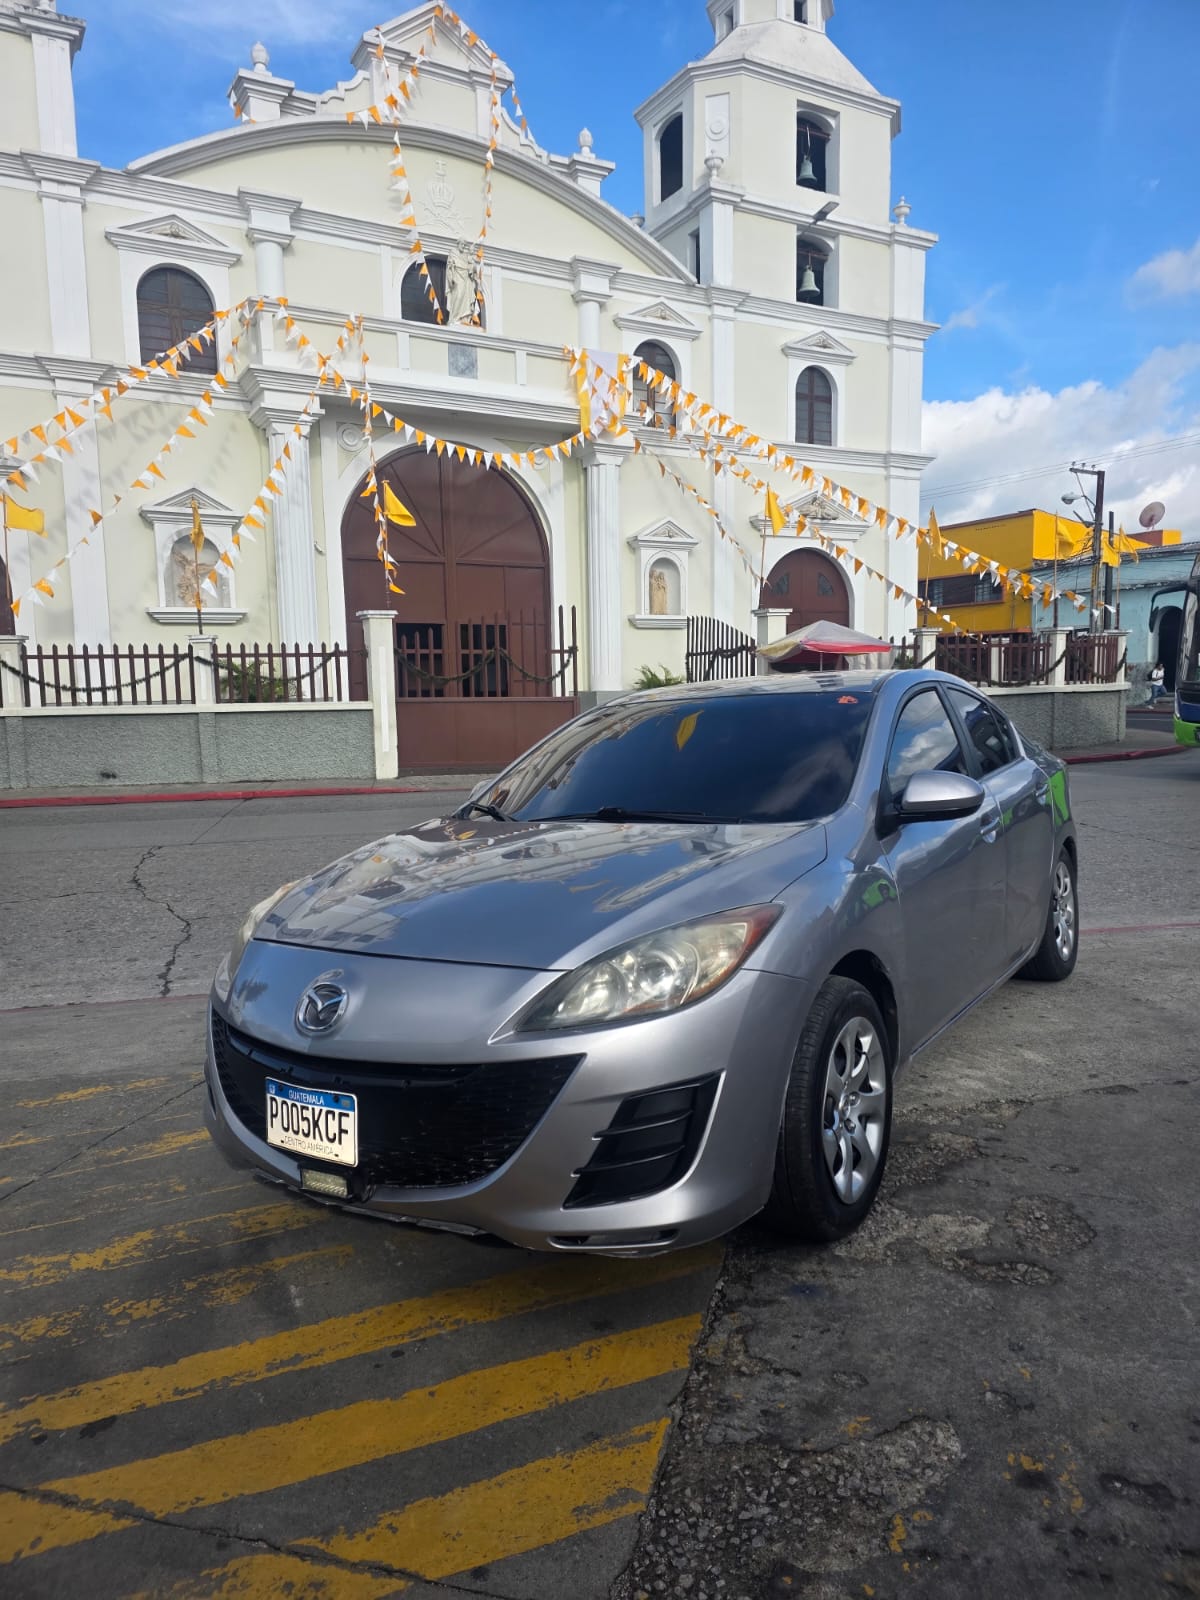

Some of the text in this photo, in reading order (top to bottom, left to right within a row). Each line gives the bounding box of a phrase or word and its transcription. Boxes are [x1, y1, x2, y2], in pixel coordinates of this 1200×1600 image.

[288, 1090, 325, 1105] GUATEMALA
[269, 1096, 350, 1146] P005KCF
[284, 1135, 307, 1150] CENTRO
